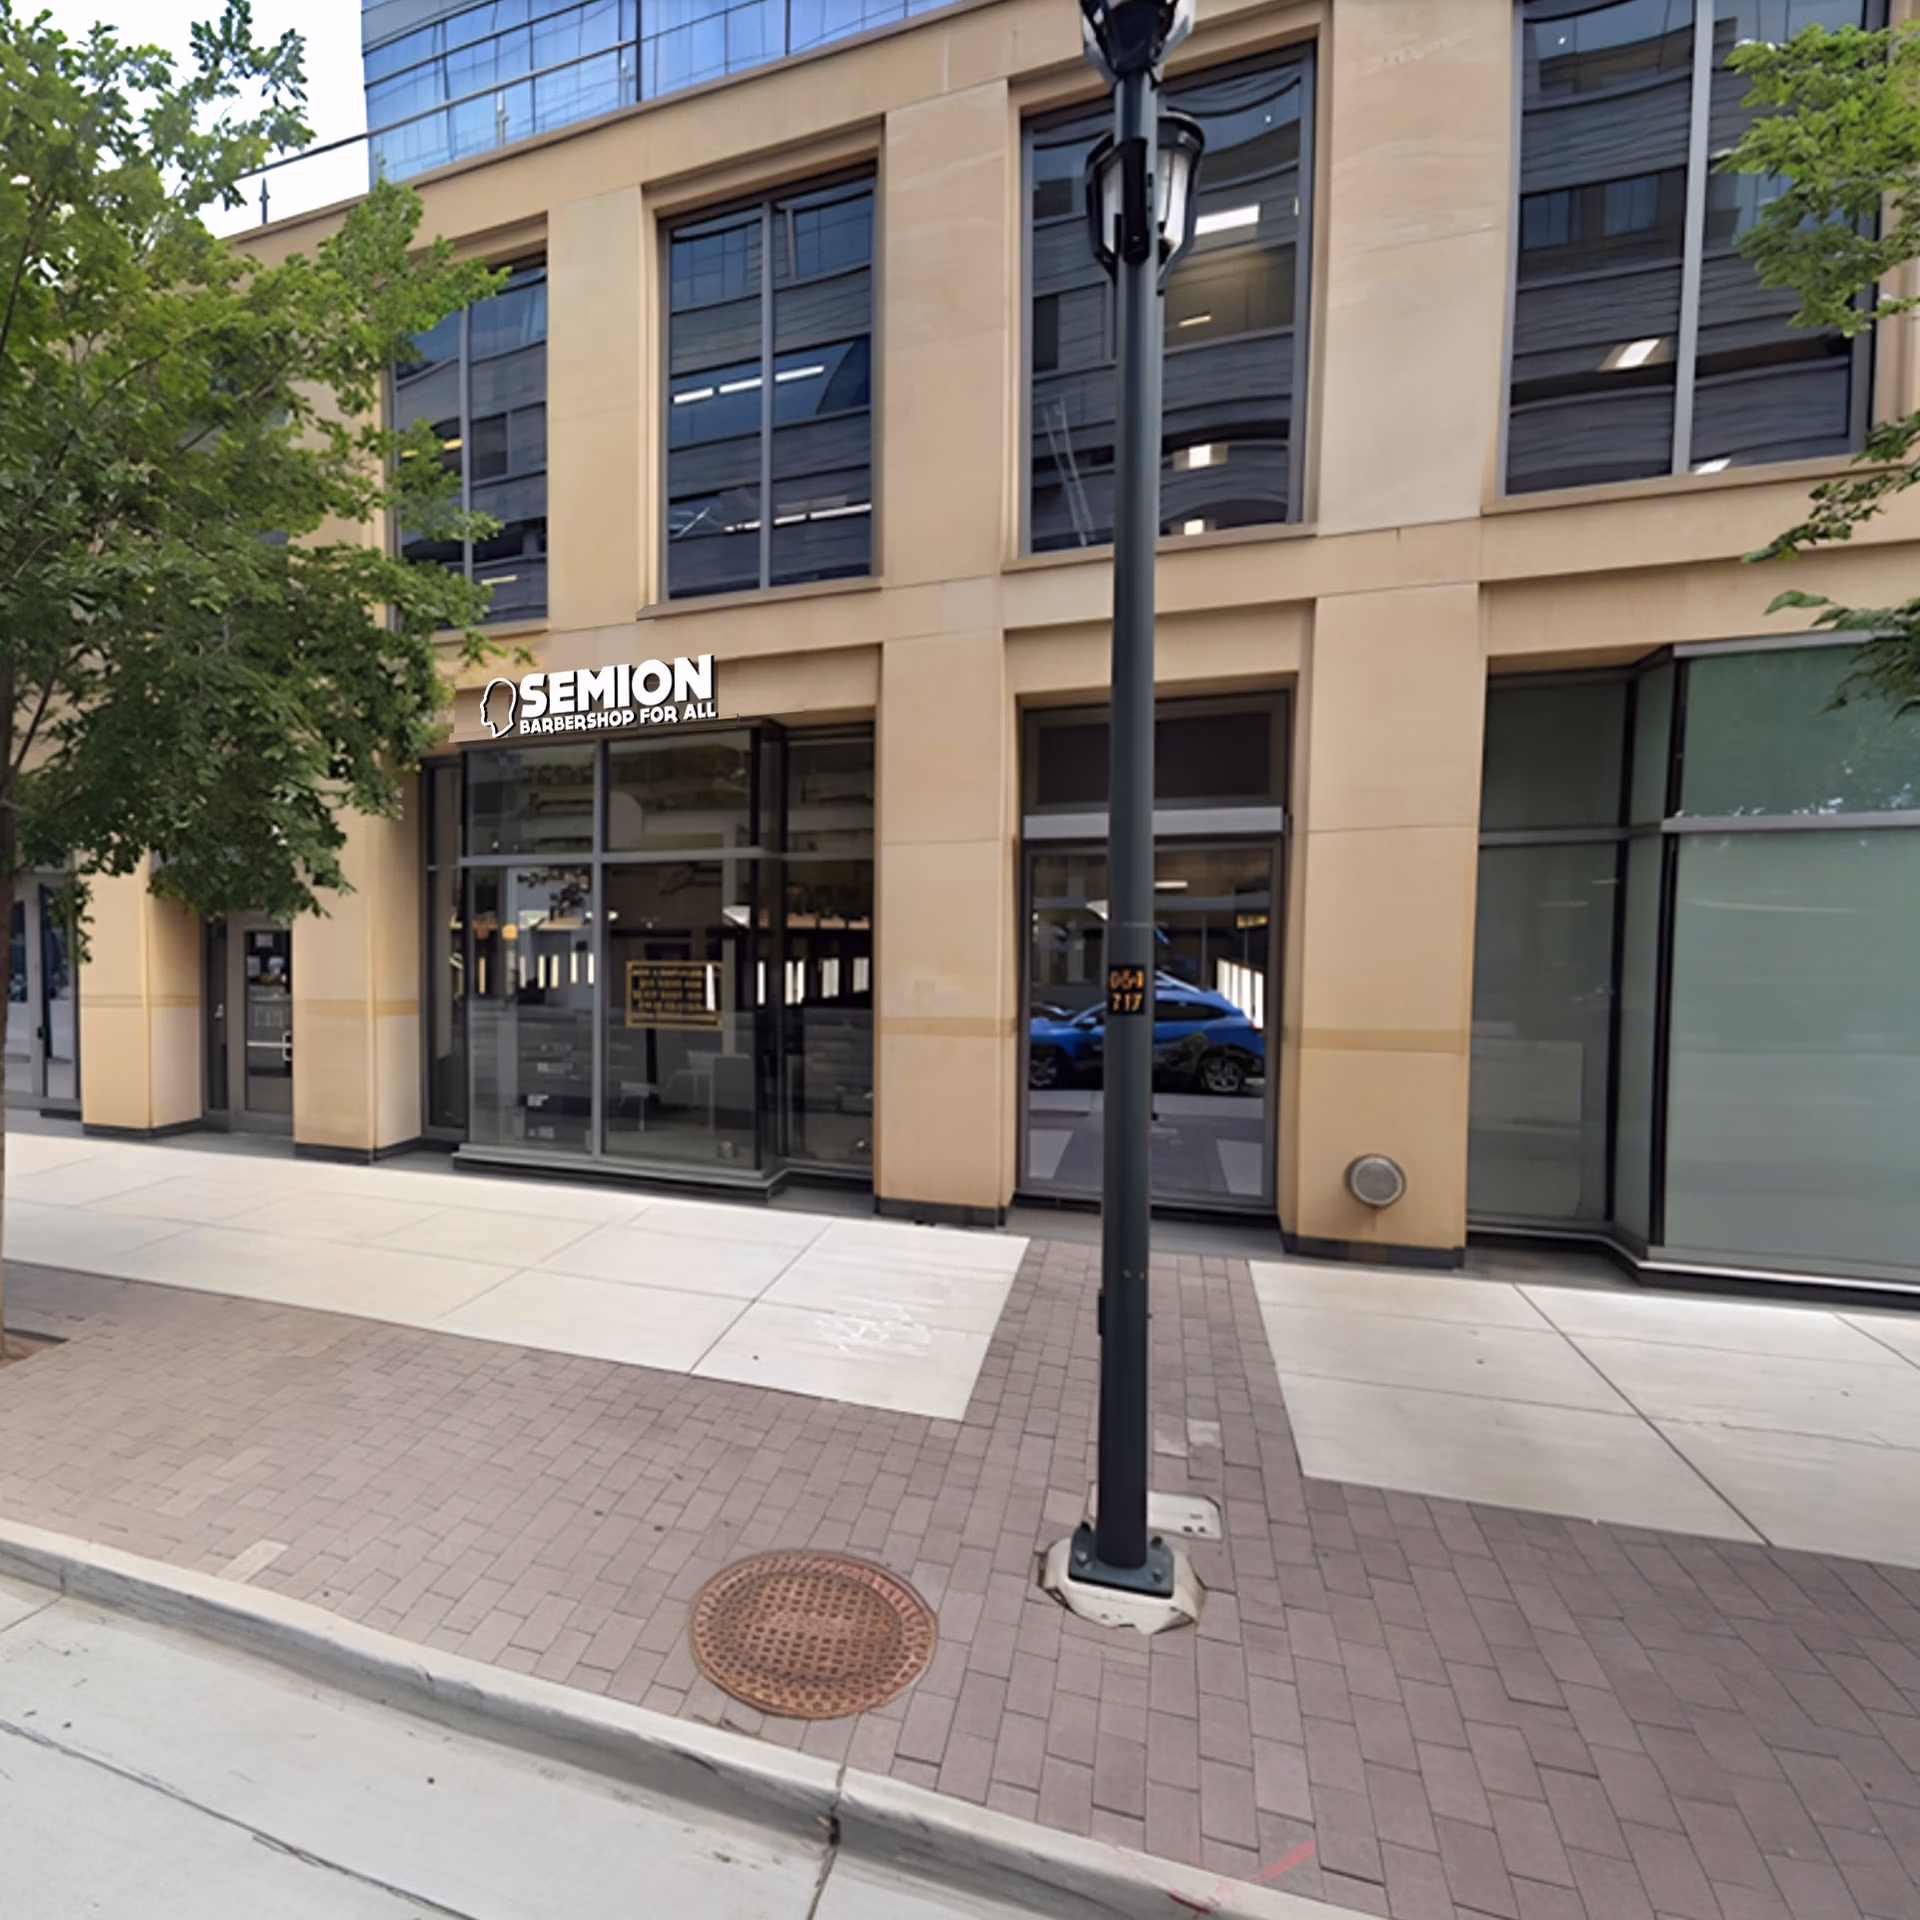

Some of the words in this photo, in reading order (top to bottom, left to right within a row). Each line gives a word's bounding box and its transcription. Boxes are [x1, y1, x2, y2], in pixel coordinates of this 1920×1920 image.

[520, 654, 713, 718] SEMION
[519, 709, 635, 735] BARBERSHOP
[640, 705, 679, 724] FOR
[683, 702, 717, 720] ALL
